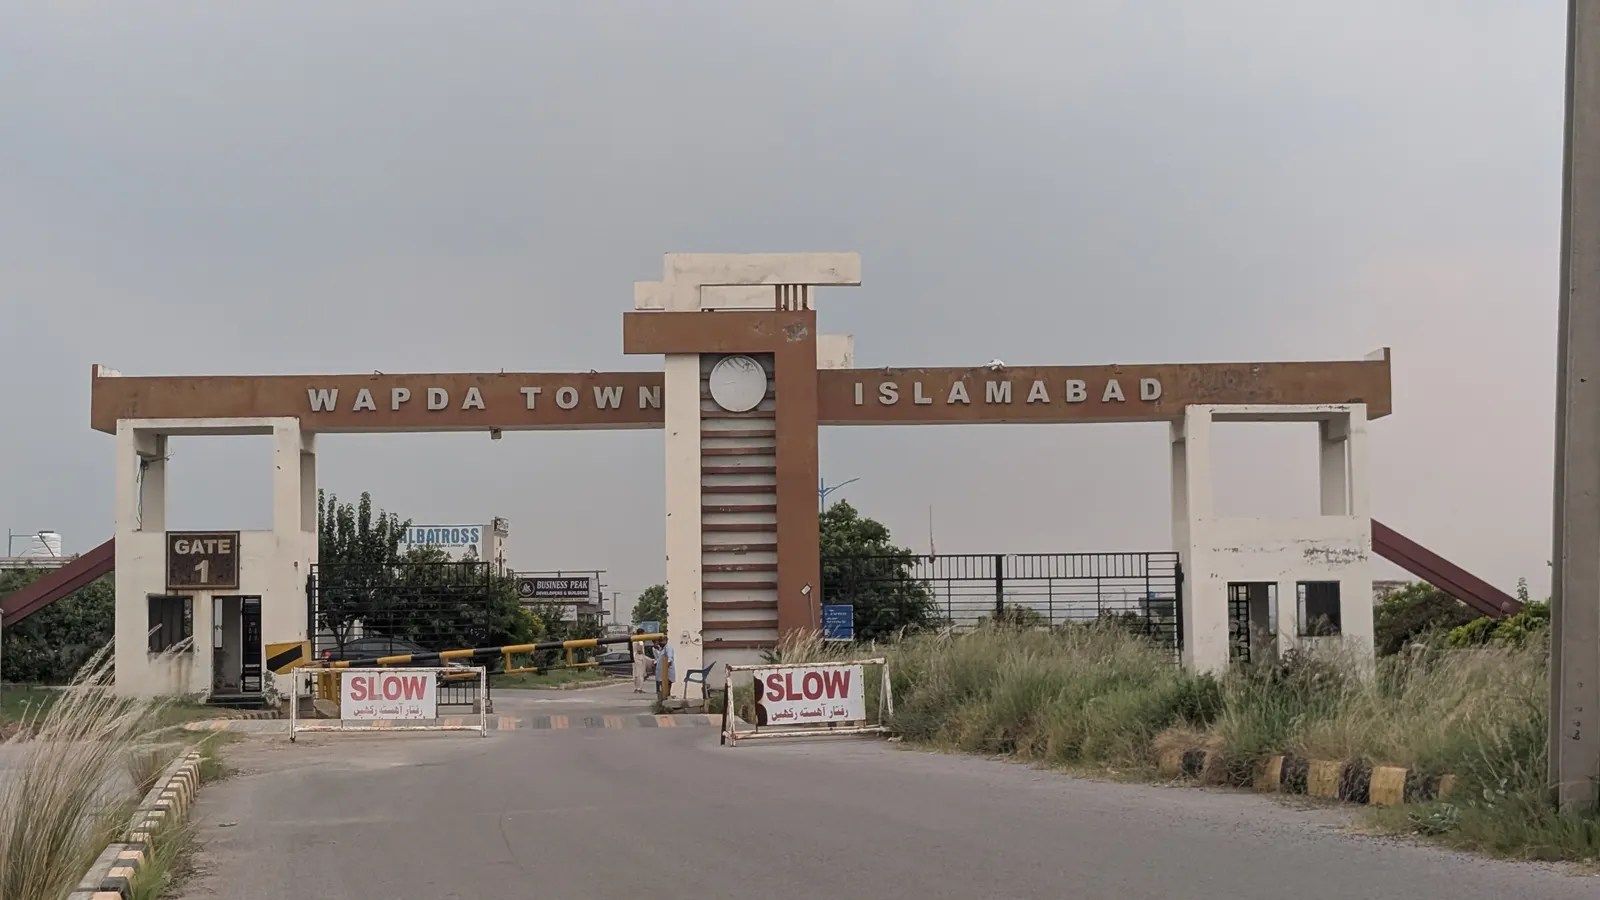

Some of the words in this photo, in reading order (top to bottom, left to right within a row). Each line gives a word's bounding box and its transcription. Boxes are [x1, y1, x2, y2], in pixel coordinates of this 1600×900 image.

[307, 387, 486, 412] WAPDA
[520, 386, 661, 410] TOWN
[854, 377, 1163, 405] ISLAMABAD
[174, 539, 231, 555] GATE
[194, 559, 209, 583] 1
[536, 580, 568, 589] BUSINESS
[569, 580, 588, 589] PEAK
[350, 676, 427, 701] SLOW
[766, 669, 851, 702] SLOW
[405, 704, 423, 716] رفتار
[829, 705, 849, 718] رفتار
